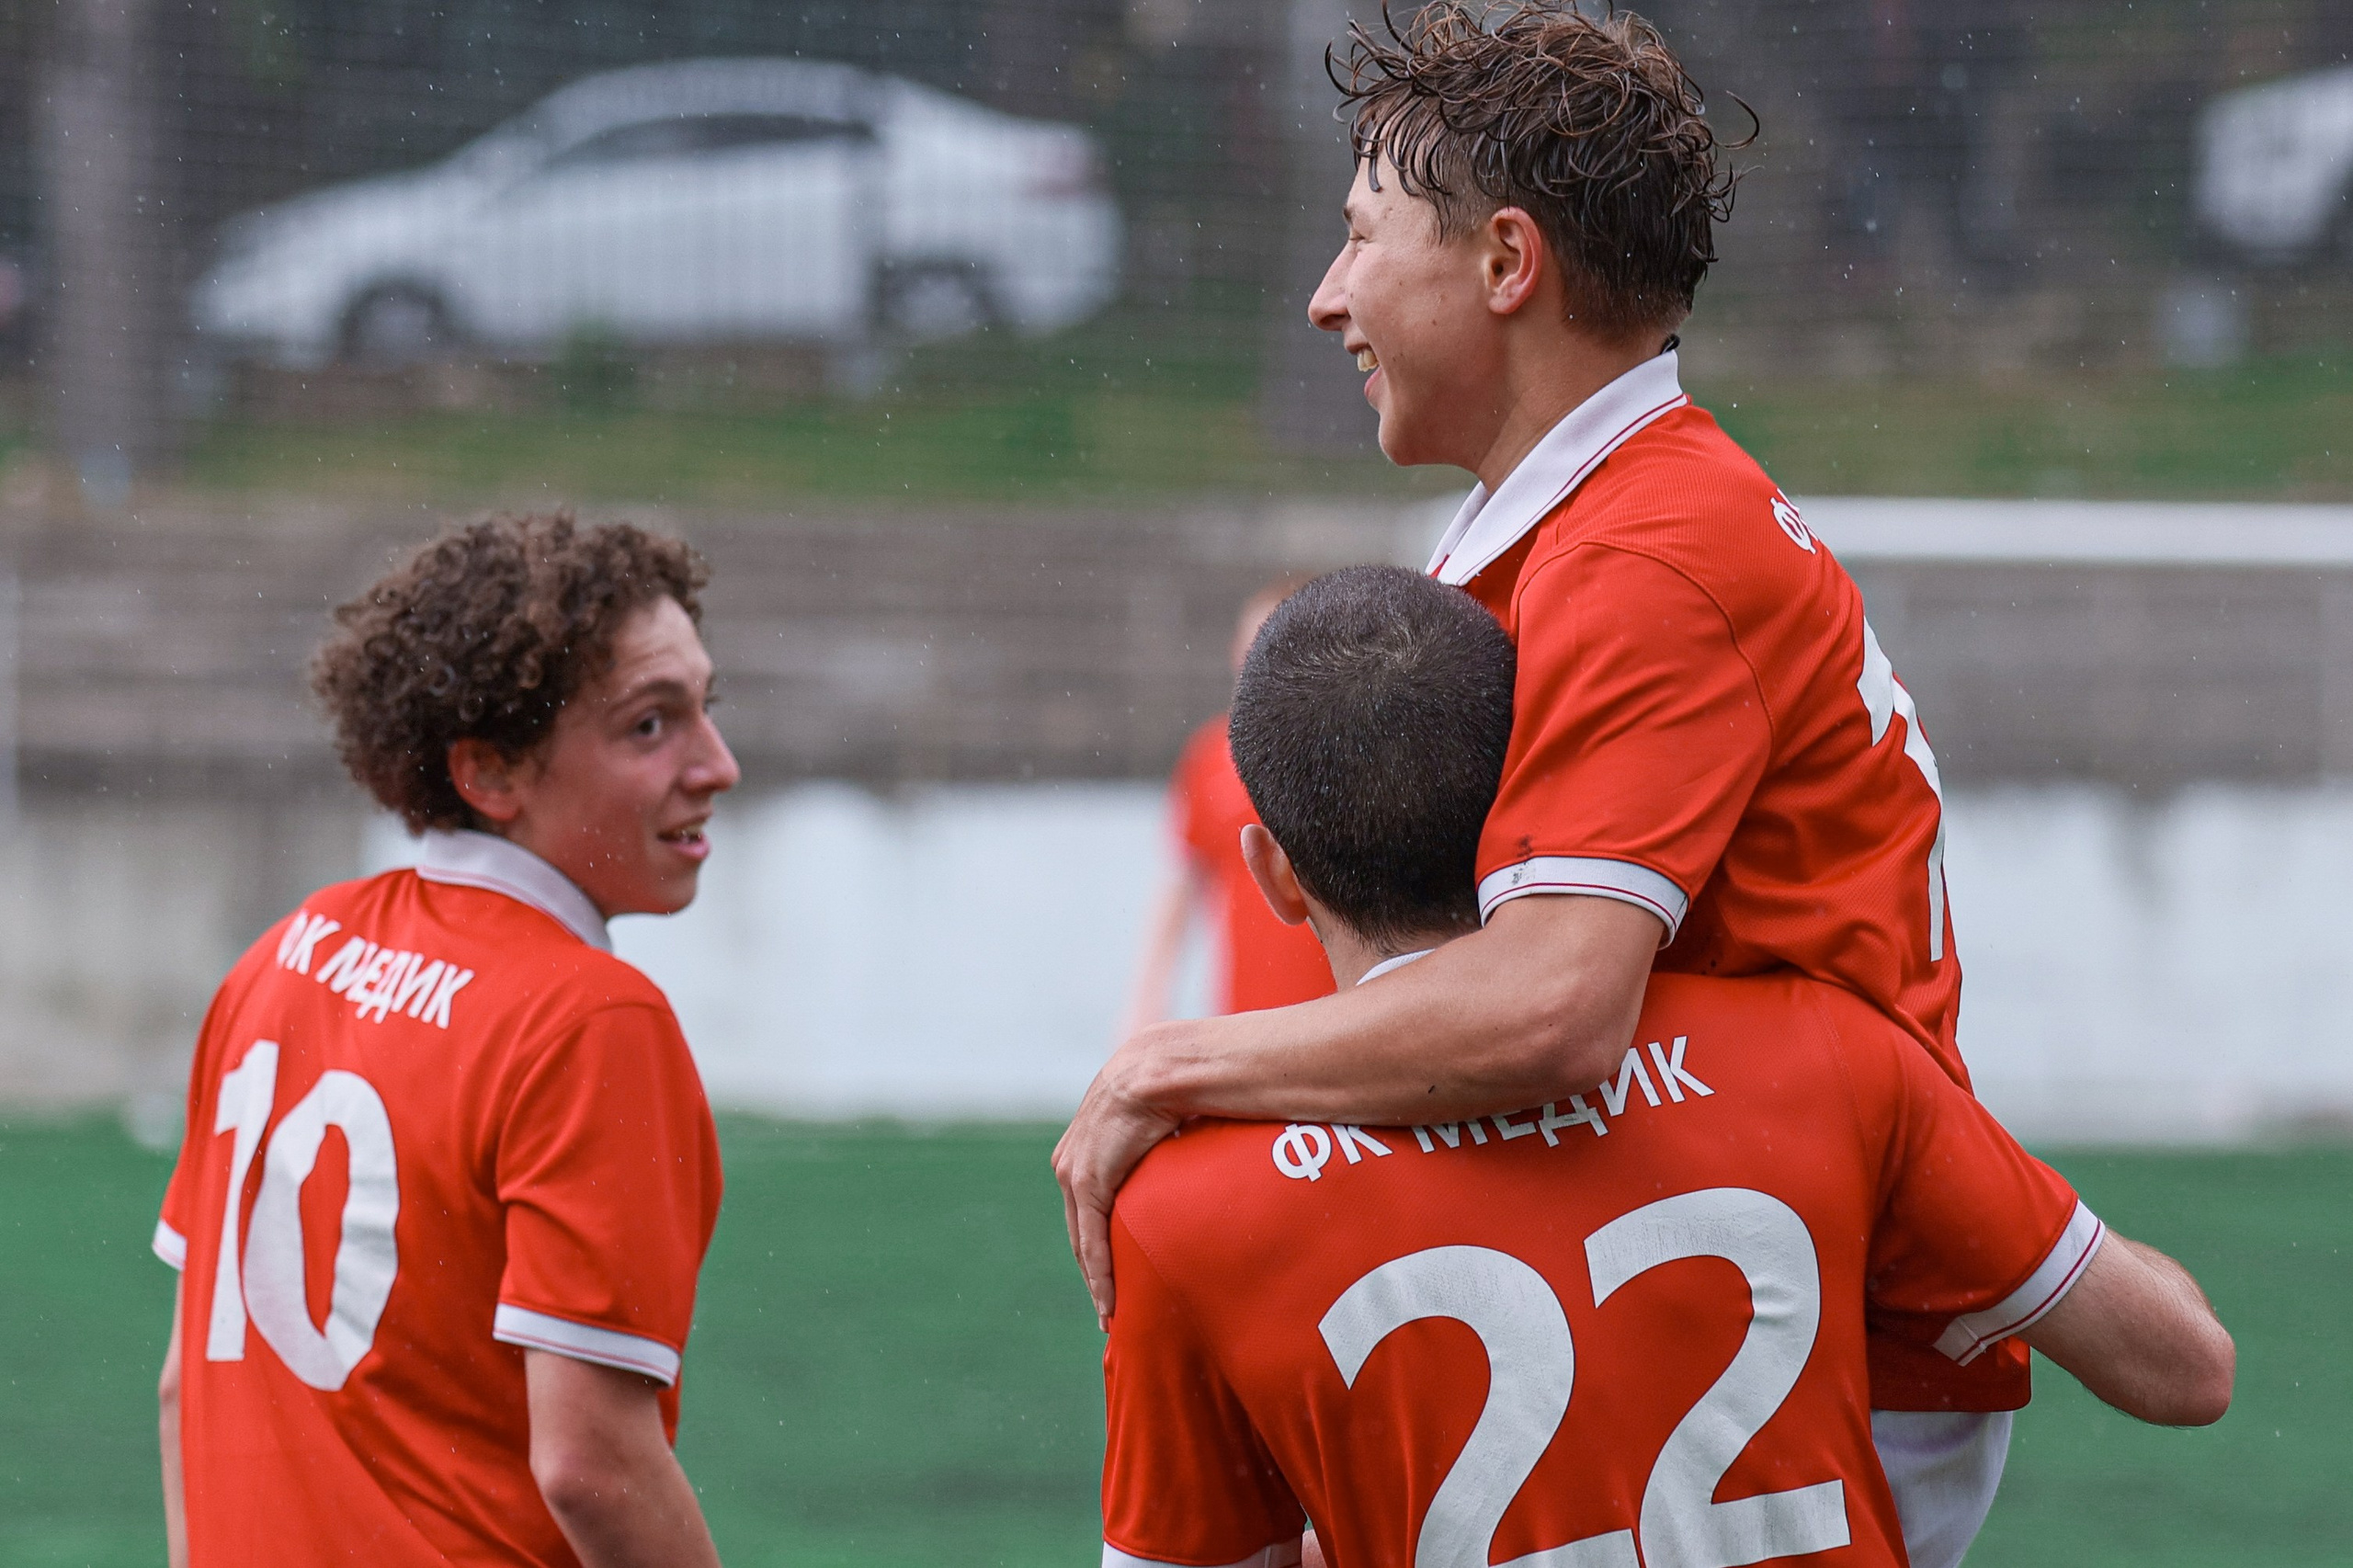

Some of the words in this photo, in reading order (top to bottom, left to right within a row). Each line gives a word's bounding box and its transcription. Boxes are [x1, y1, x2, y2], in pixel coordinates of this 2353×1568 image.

[1770, 487, 1819, 555] Ф
[314, 935, 475, 1029] МЕДИК
[1272, 1123, 1393, 1182] ФК
[206, 1039, 400, 1392] 10
[1317, 1187, 1851, 1568] 22
